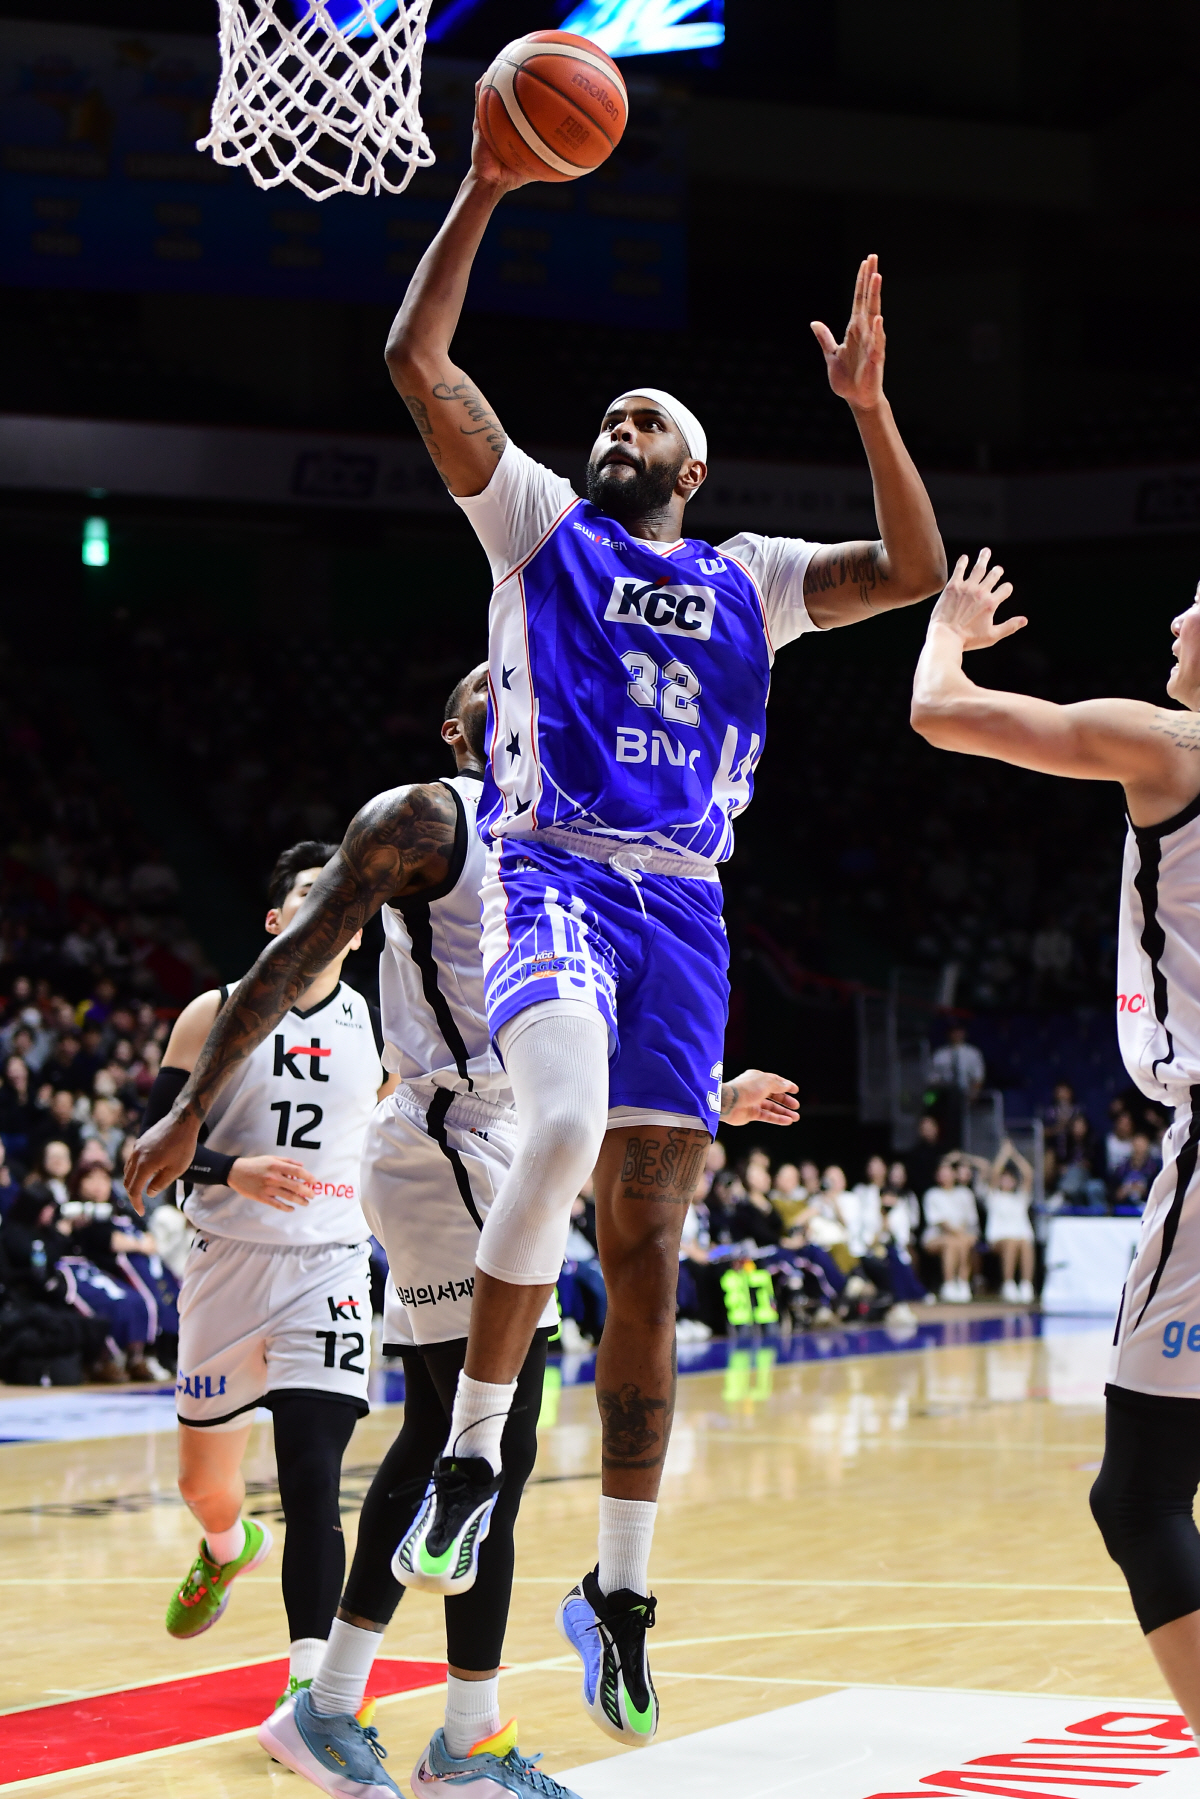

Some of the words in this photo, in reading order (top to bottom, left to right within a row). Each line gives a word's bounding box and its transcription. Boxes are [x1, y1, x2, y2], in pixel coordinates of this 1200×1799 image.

[571, 73, 619, 122] molten
[560, 115, 590, 144] FIBA
[617, 580, 705, 631] KCC
[619, 650, 702, 728] 32
[273, 1034, 332, 1083] kt
[270, 1100, 324, 1150] 12
[327, 1295, 361, 1321] kt
[315, 1330, 365, 1375] 12
